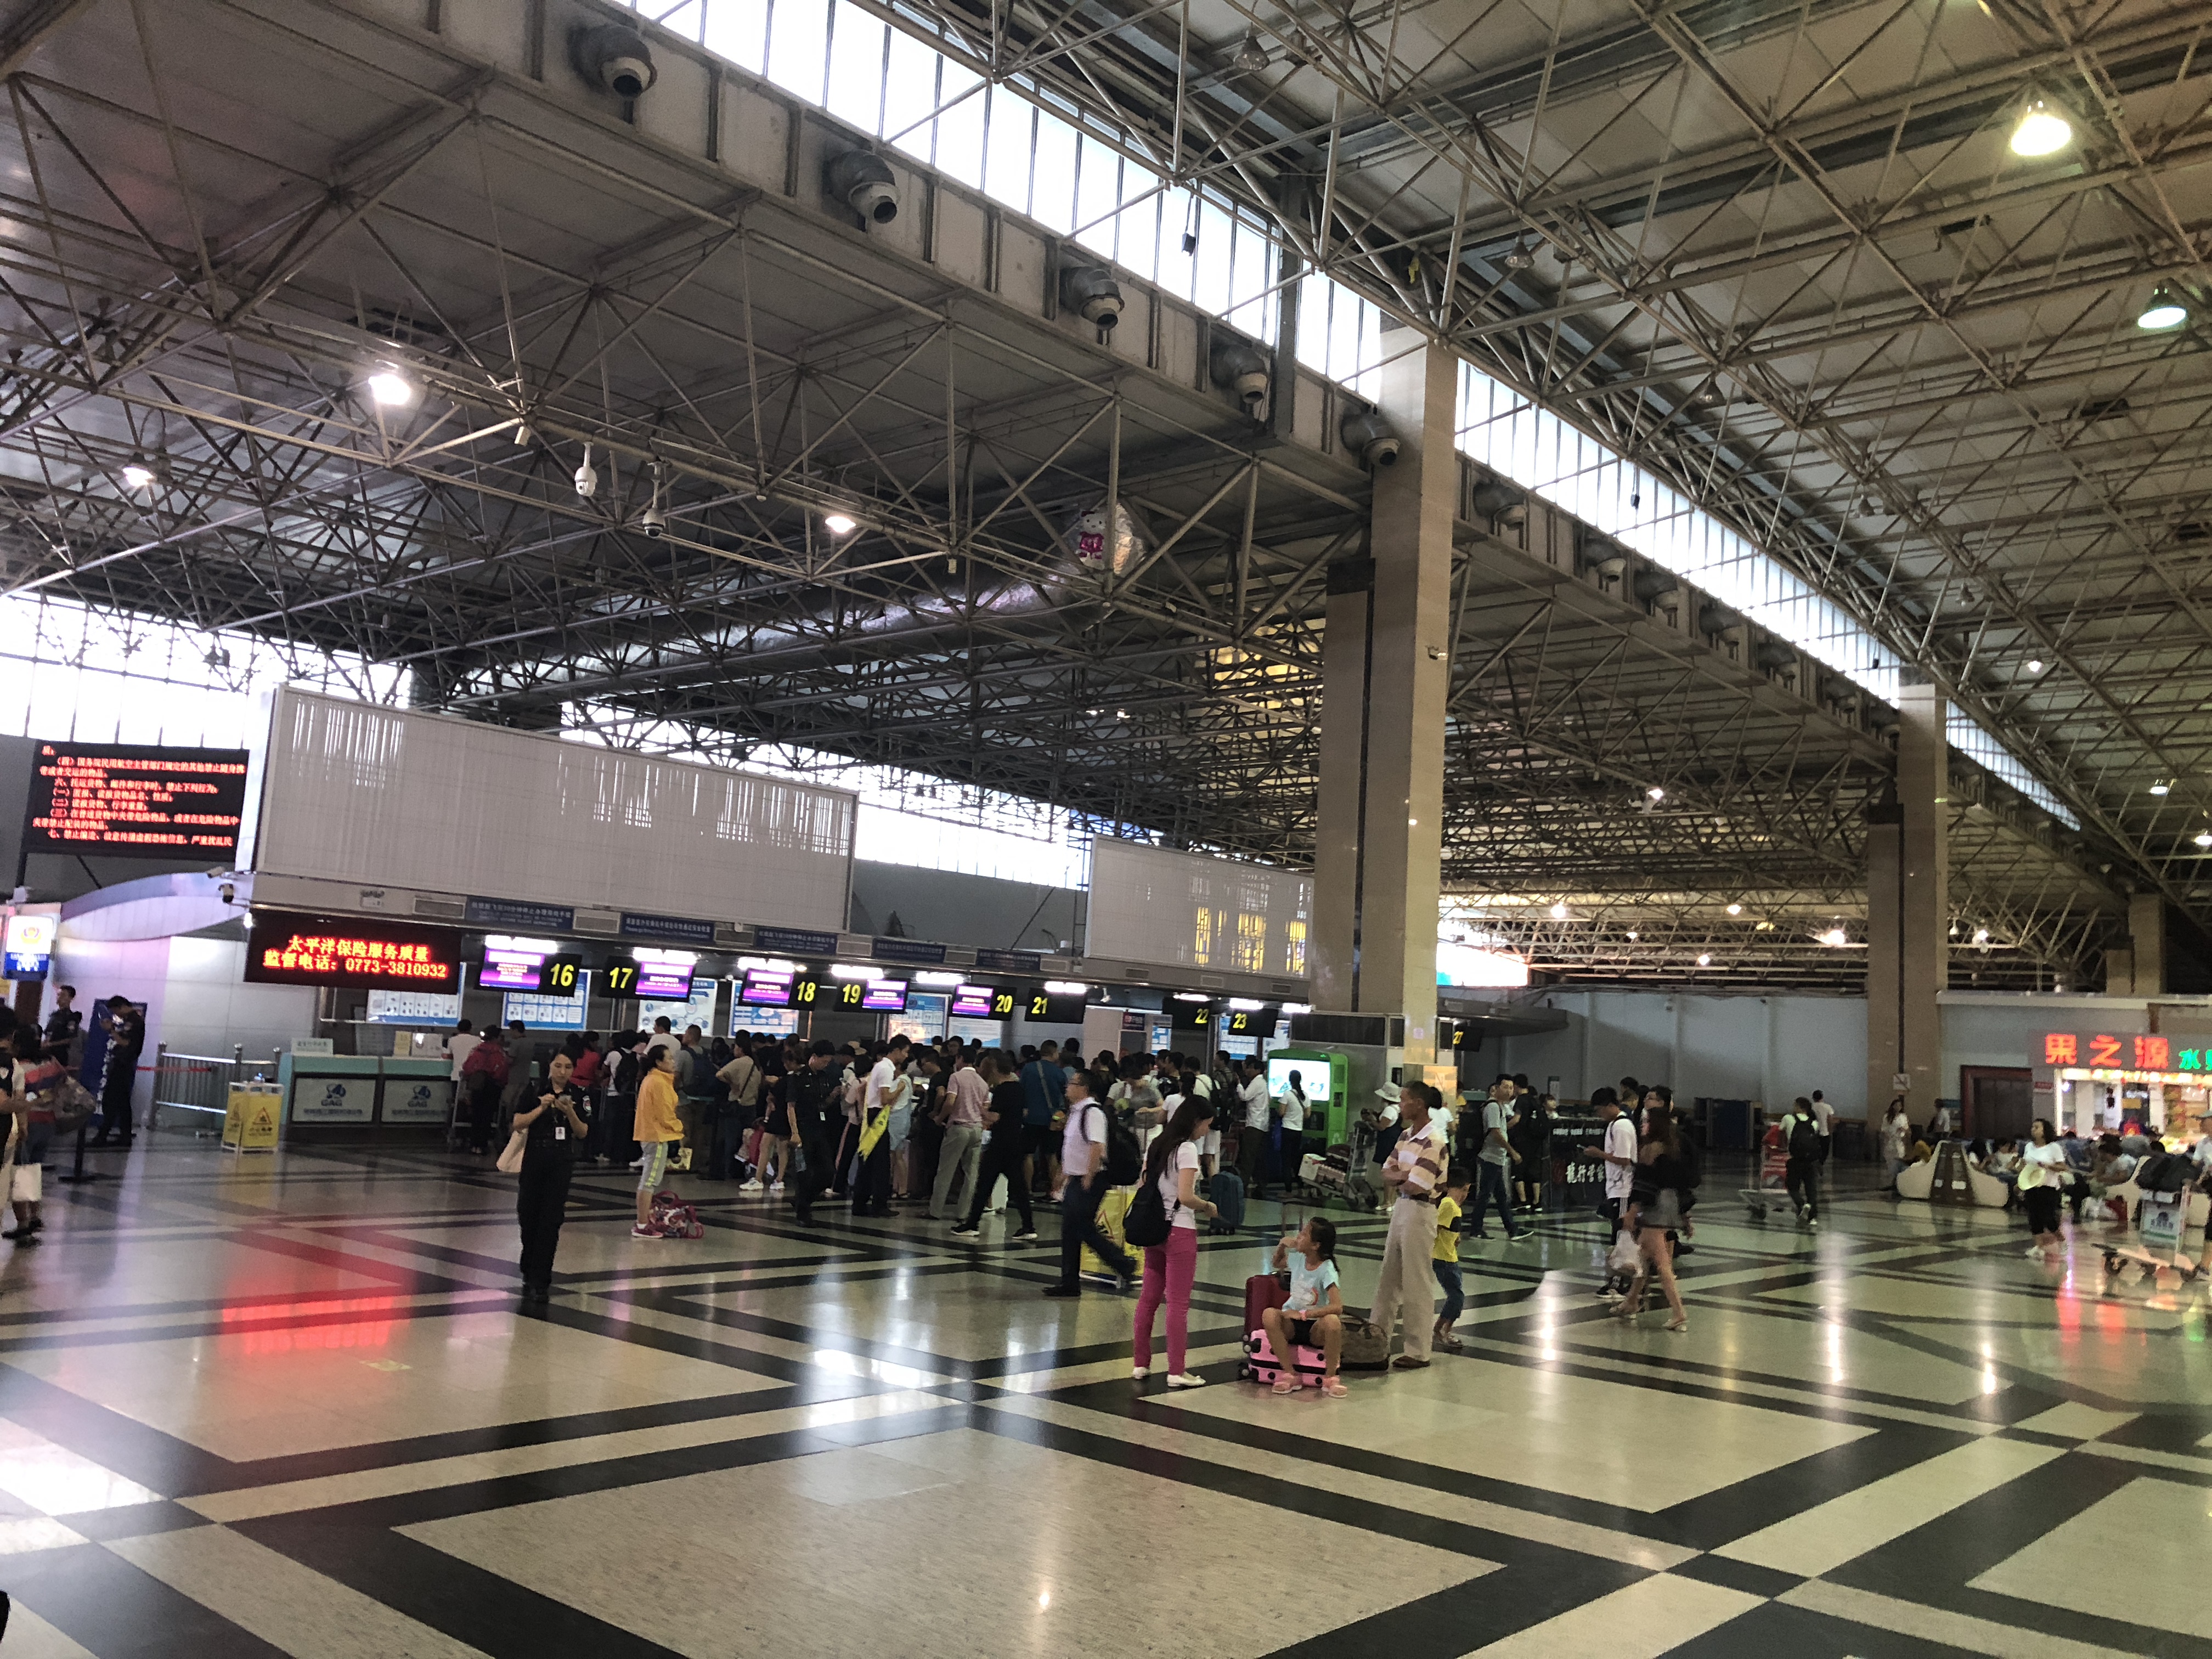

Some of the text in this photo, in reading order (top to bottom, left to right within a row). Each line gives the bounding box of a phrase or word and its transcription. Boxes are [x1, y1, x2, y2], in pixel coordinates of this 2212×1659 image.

[288, 934, 430, 962] 太平洋保险服务质量
[550, 963, 574, 987] 16
[610, 967, 633, 989] 17
[797, 981, 816, 1002] 18
[843, 984, 861, 1003] 19
[995, 994, 1013, 1013] 20
[1031, 996, 1048, 1014] 21
[1194, 1008, 1209, 1024] 22
[1233, 1013, 1247, 1029] 23
[2045, 1033, 2212, 1070] 果之源 水
